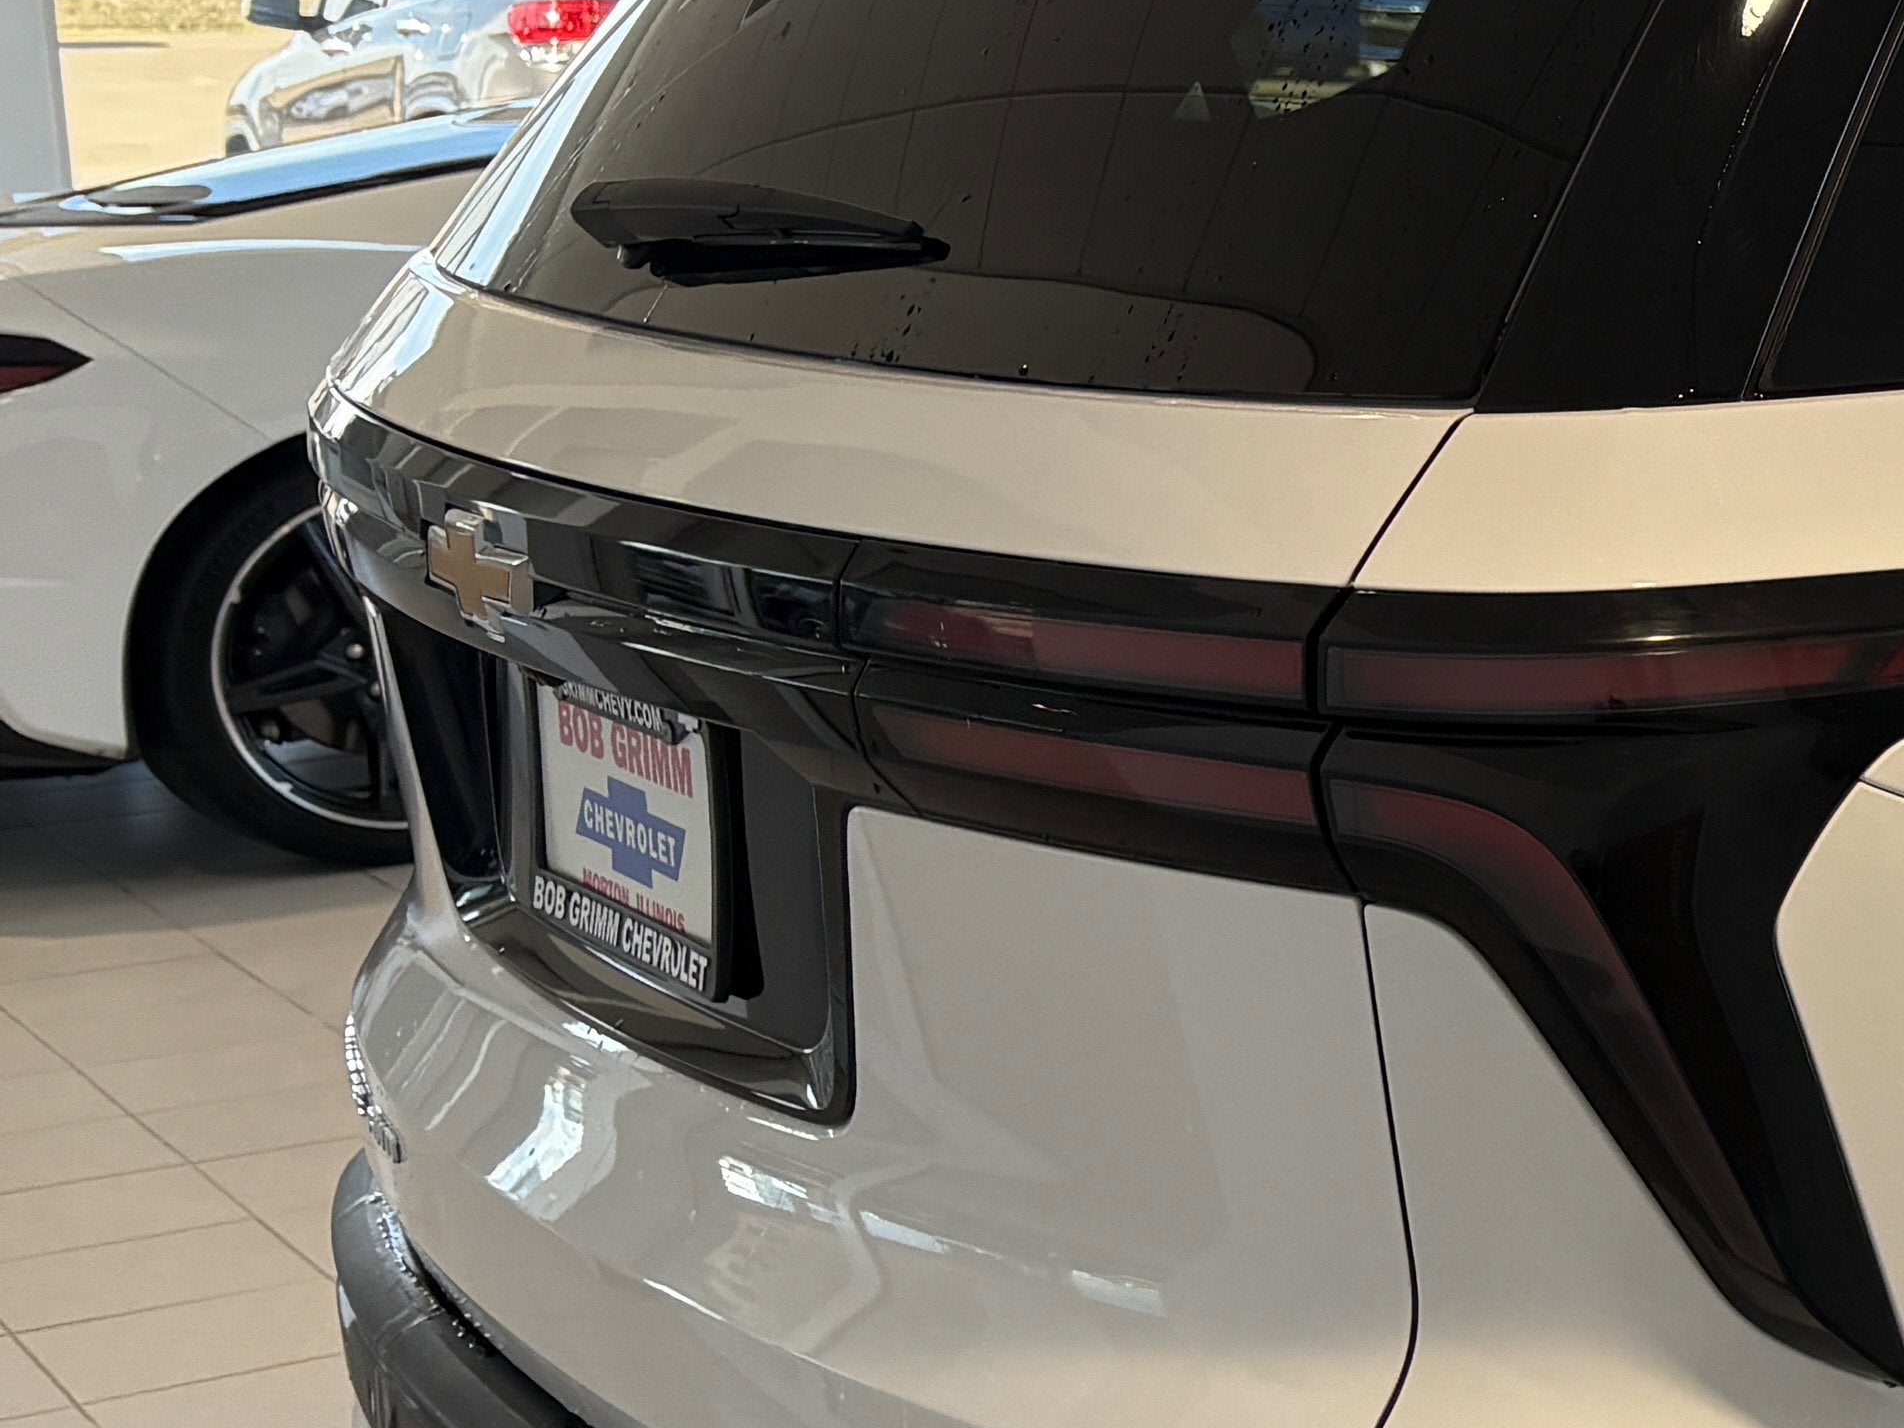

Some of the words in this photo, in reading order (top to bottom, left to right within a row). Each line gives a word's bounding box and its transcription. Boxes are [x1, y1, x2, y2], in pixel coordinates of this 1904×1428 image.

[558, 700, 604, 760] BOB
[611, 723, 694, 799] GRIMM
[583, 799, 676, 868] CHEVROLET
[533, 875, 565, 920] BOB
[569, 892, 619, 947] GRIMM
[622, 917, 708, 992] CHEVROLET
